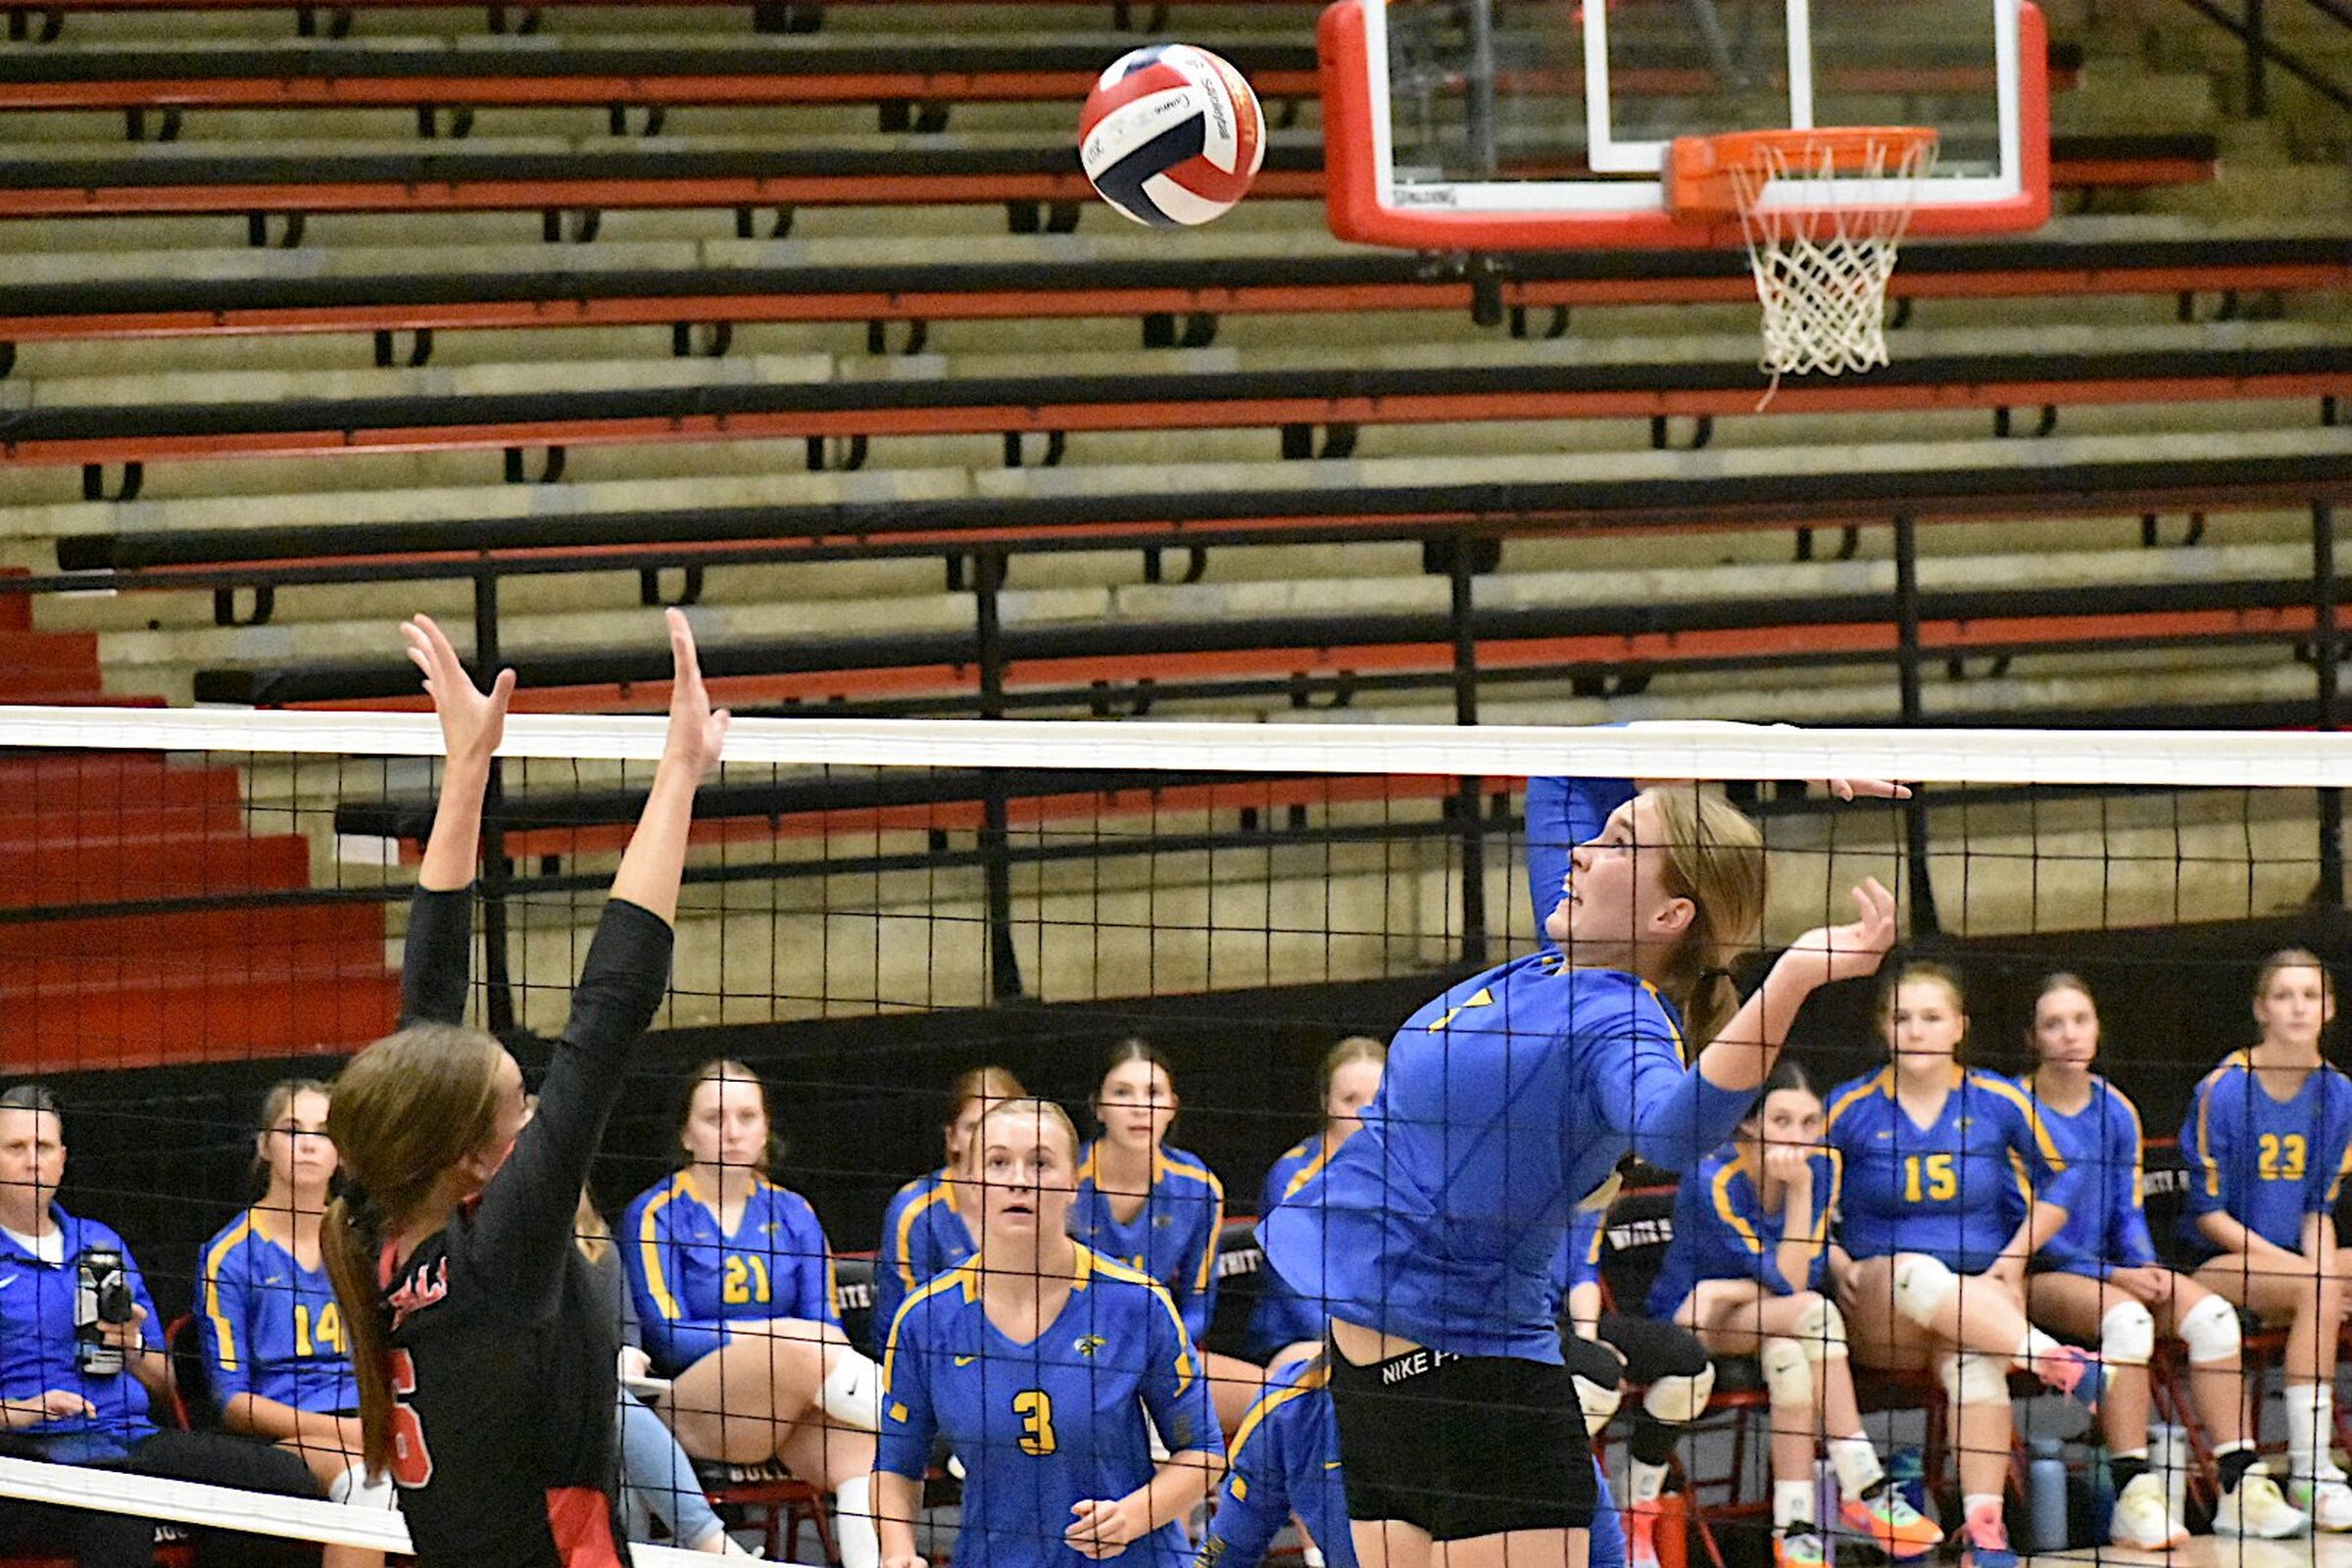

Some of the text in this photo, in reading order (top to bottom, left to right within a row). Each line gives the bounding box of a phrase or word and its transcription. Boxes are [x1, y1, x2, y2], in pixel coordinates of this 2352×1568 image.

[1904, 1153, 1957, 1202] 15
[2258, 1133, 2306, 1180] 23
[723, 1254, 770, 1303] 21
[838, 1284, 871, 1310] ITE
[295, 1301, 346, 1356] 14
[1382, 1352, 1429, 1385] NIKE
[1011, 1389, 1057, 1456] 3
